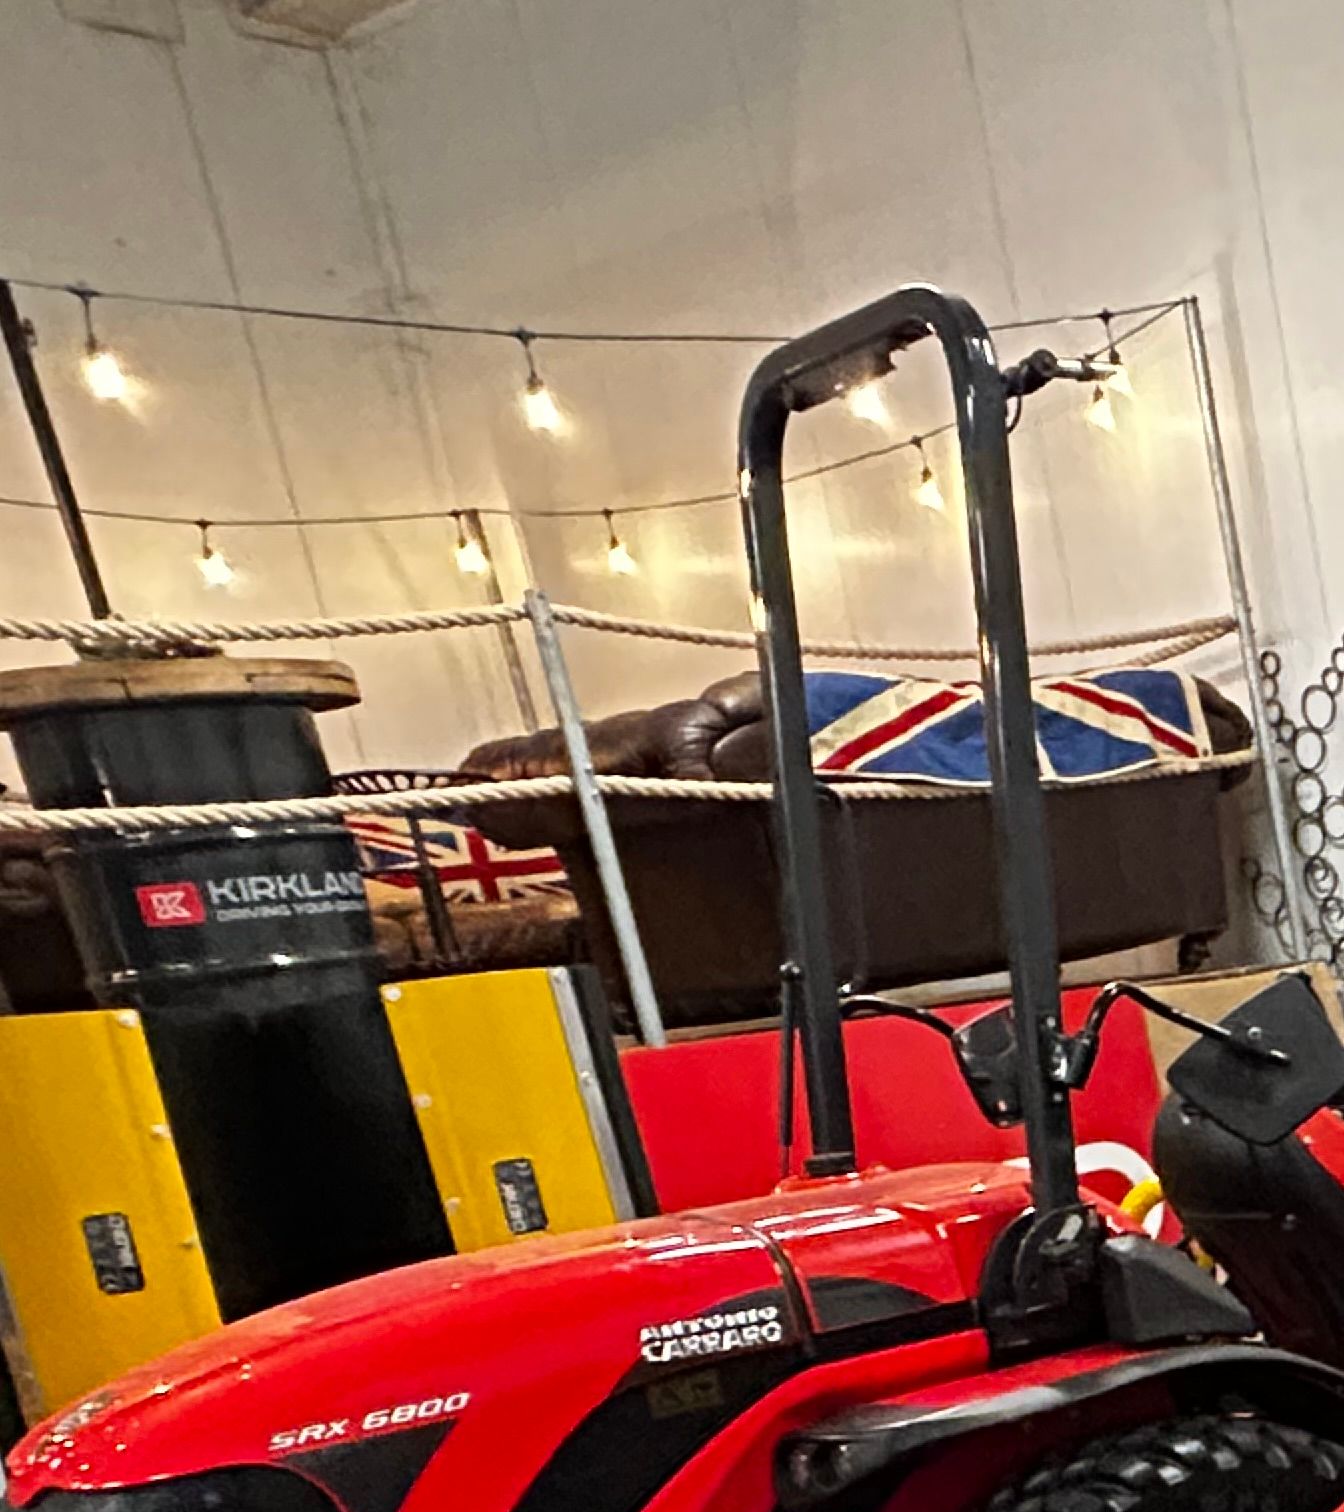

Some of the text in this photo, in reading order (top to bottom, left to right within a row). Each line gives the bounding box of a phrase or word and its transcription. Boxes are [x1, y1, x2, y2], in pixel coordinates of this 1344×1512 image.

[640, 1306, 778, 1342] ANTONIO
[640, 1321, 782, 1362] CARRARO
[268, 1392, 471, 1451] SRX 6800
